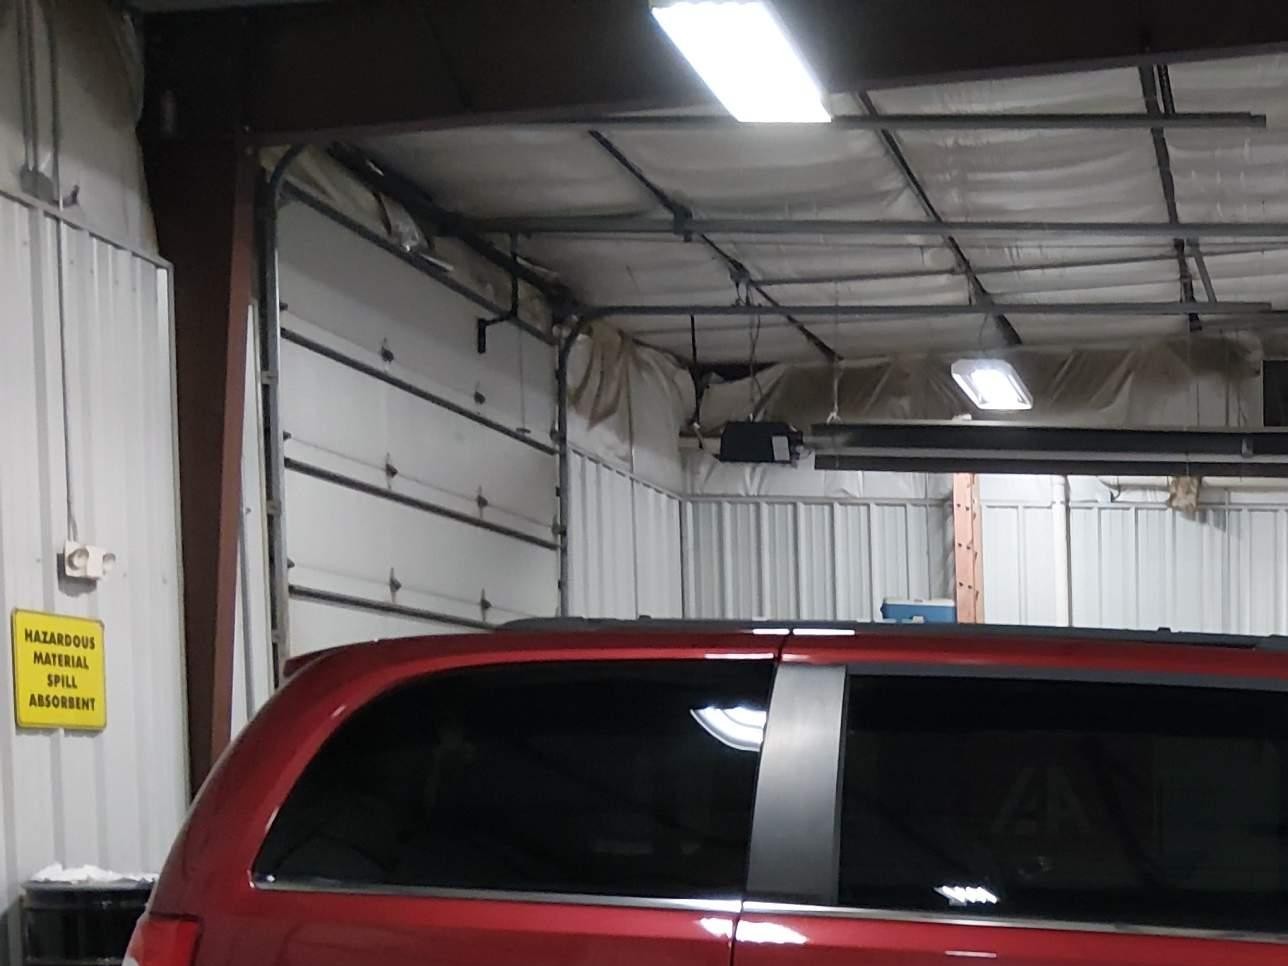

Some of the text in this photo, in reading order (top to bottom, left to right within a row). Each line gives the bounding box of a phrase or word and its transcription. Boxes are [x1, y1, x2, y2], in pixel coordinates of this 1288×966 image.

[24, 628, 95, 650] HAZARDOUS
[33, 651, 89, 670] MATERIAL
[47, 673, 78, 689] SPILL
[29, 693, 96, 711] ABSORBENT
